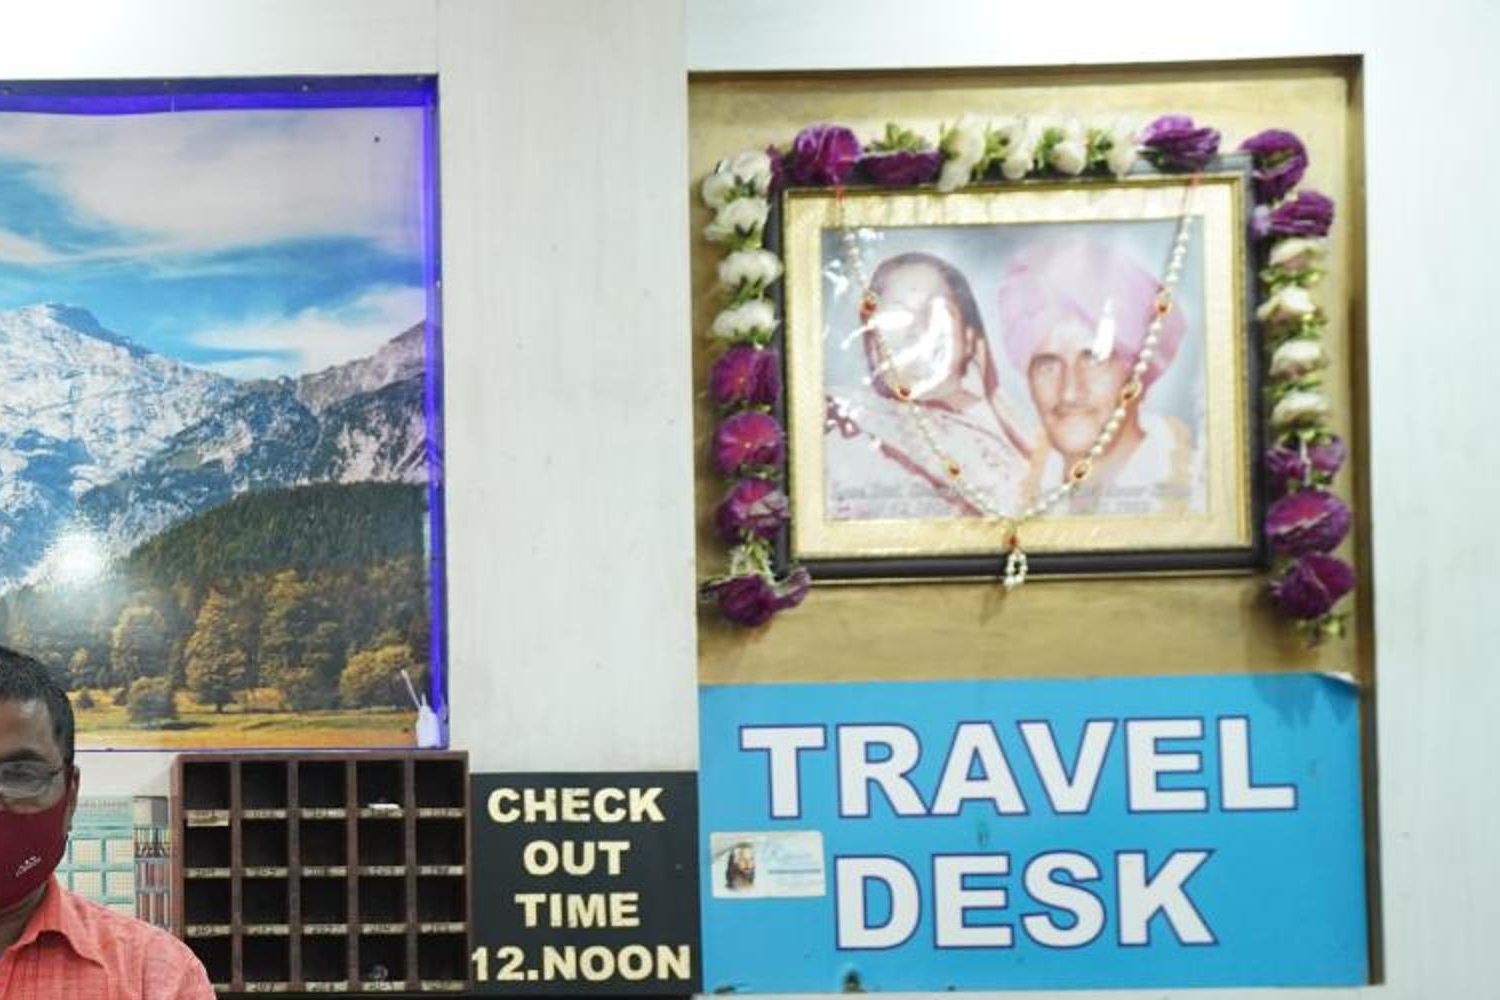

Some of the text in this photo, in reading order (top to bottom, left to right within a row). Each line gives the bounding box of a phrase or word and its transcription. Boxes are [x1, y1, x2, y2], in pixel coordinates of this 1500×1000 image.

[739, 715, 1298, 819] TRAVEL
[487, 787, 665, 824] CHECK
[522, 840, 631, 876] OUT
[514, 892, 641, 929] TIME
[834, 849, 1219, 951] DESK
[471, 945, 692, 982] 12.NOON
